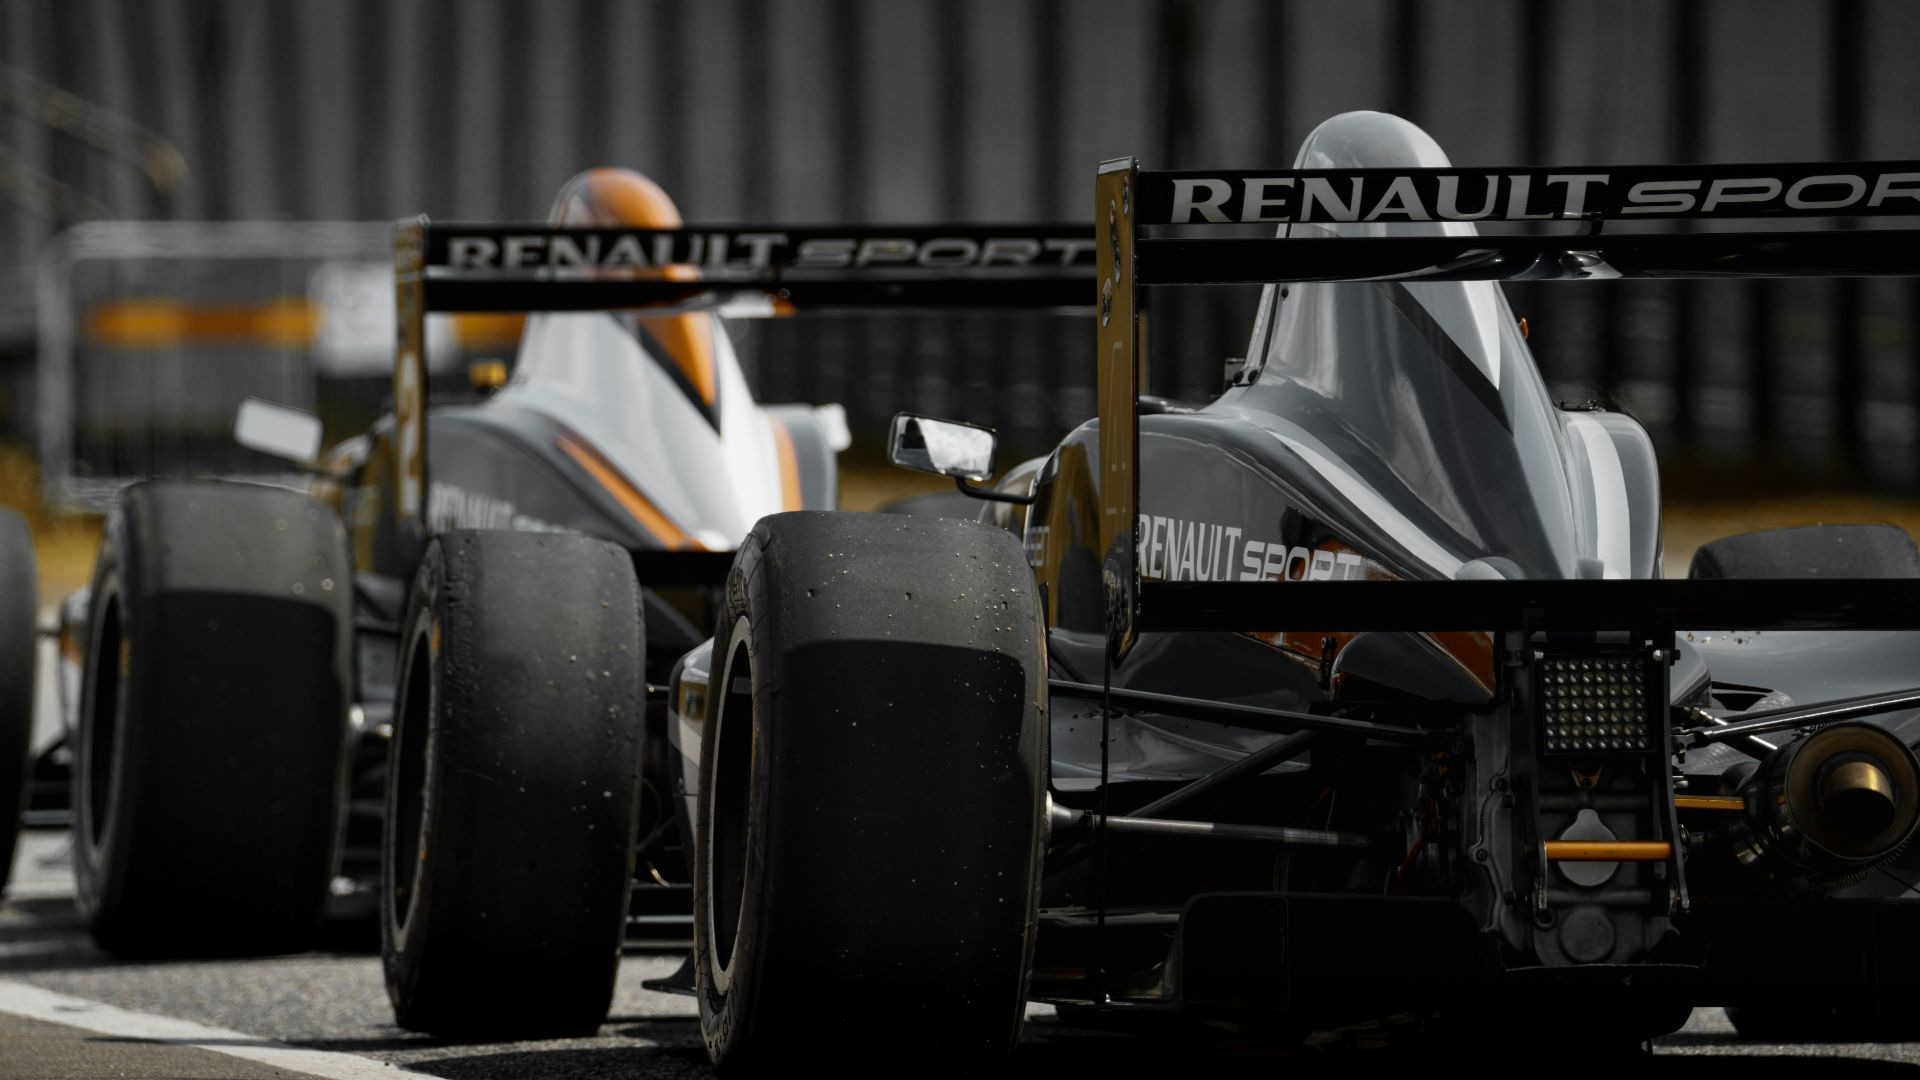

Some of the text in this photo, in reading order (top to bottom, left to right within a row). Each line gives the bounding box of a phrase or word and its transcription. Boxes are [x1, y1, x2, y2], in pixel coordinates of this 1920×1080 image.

[1170, 173, 1610, 223] RENAULT
[447, 233, 1096, 267] RENAULT SPORT
[1138, 514, 1362, 582] RENAULT SPORT
